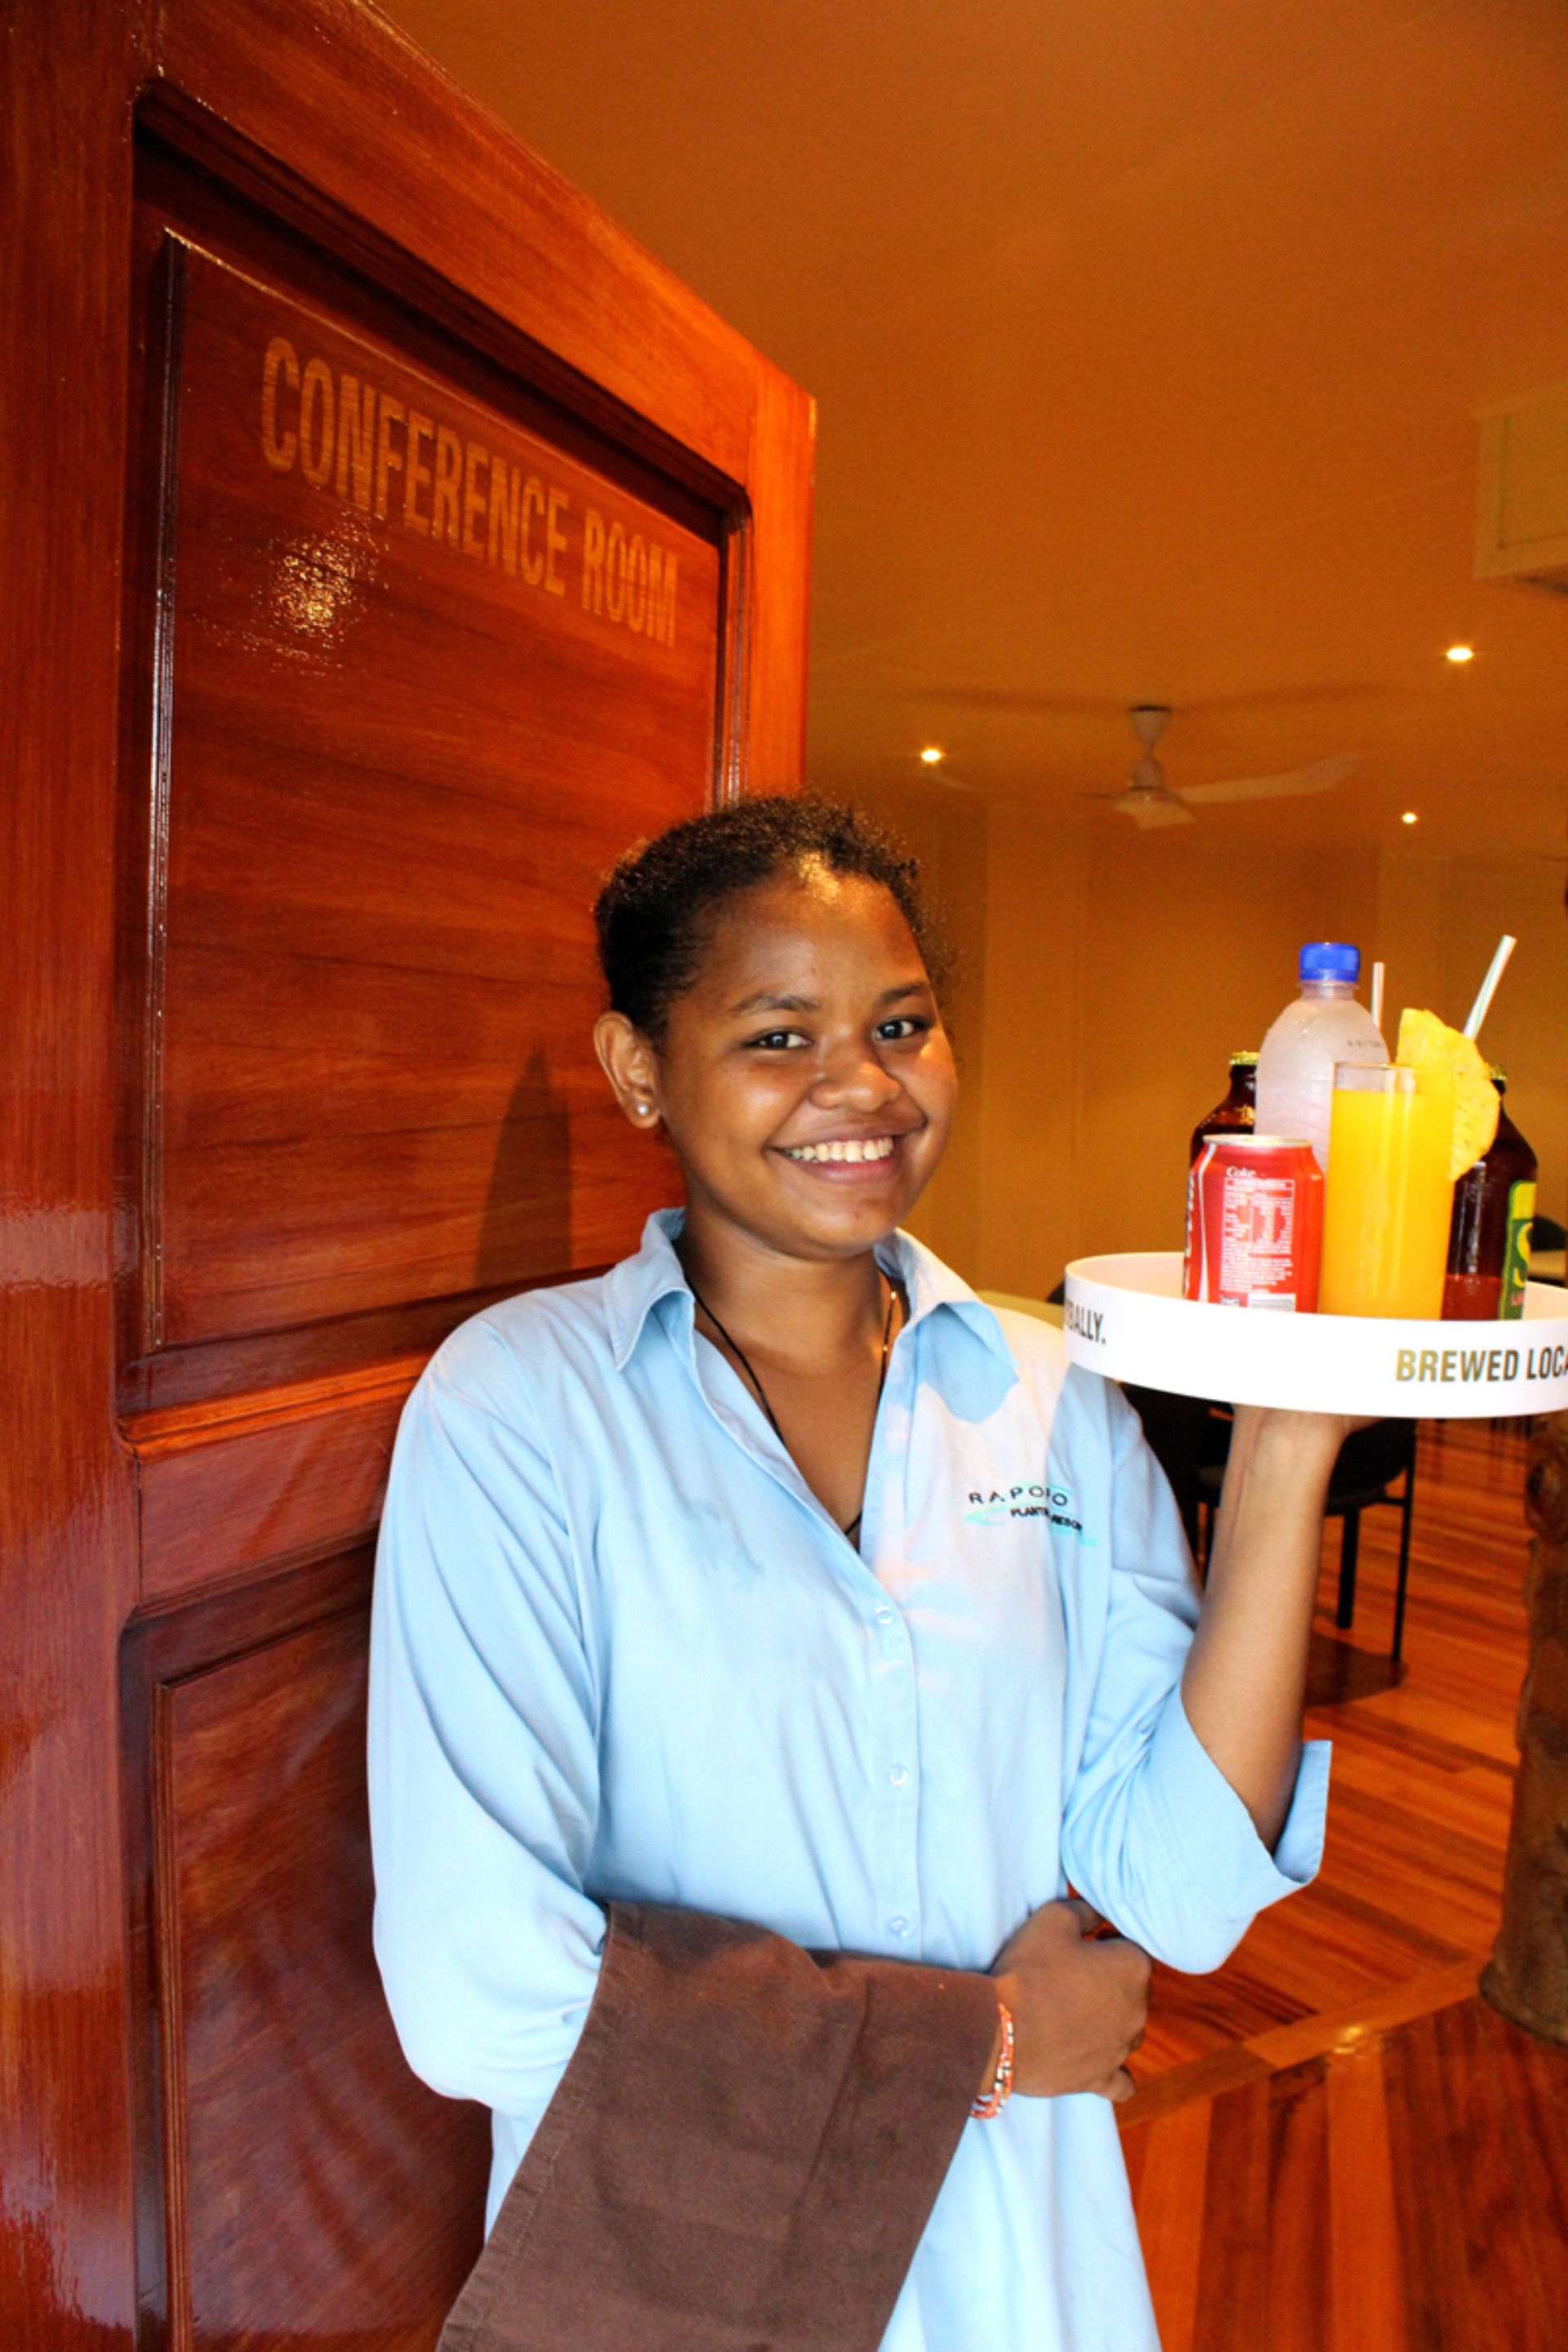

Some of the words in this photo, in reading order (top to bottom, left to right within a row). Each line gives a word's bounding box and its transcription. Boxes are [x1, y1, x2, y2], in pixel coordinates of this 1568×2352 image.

[261, 336, 569, 598] CONFERENCE
[581, 509, 679, 648] ROOM
[1396, 1349, 1519, 1382] BREWED
